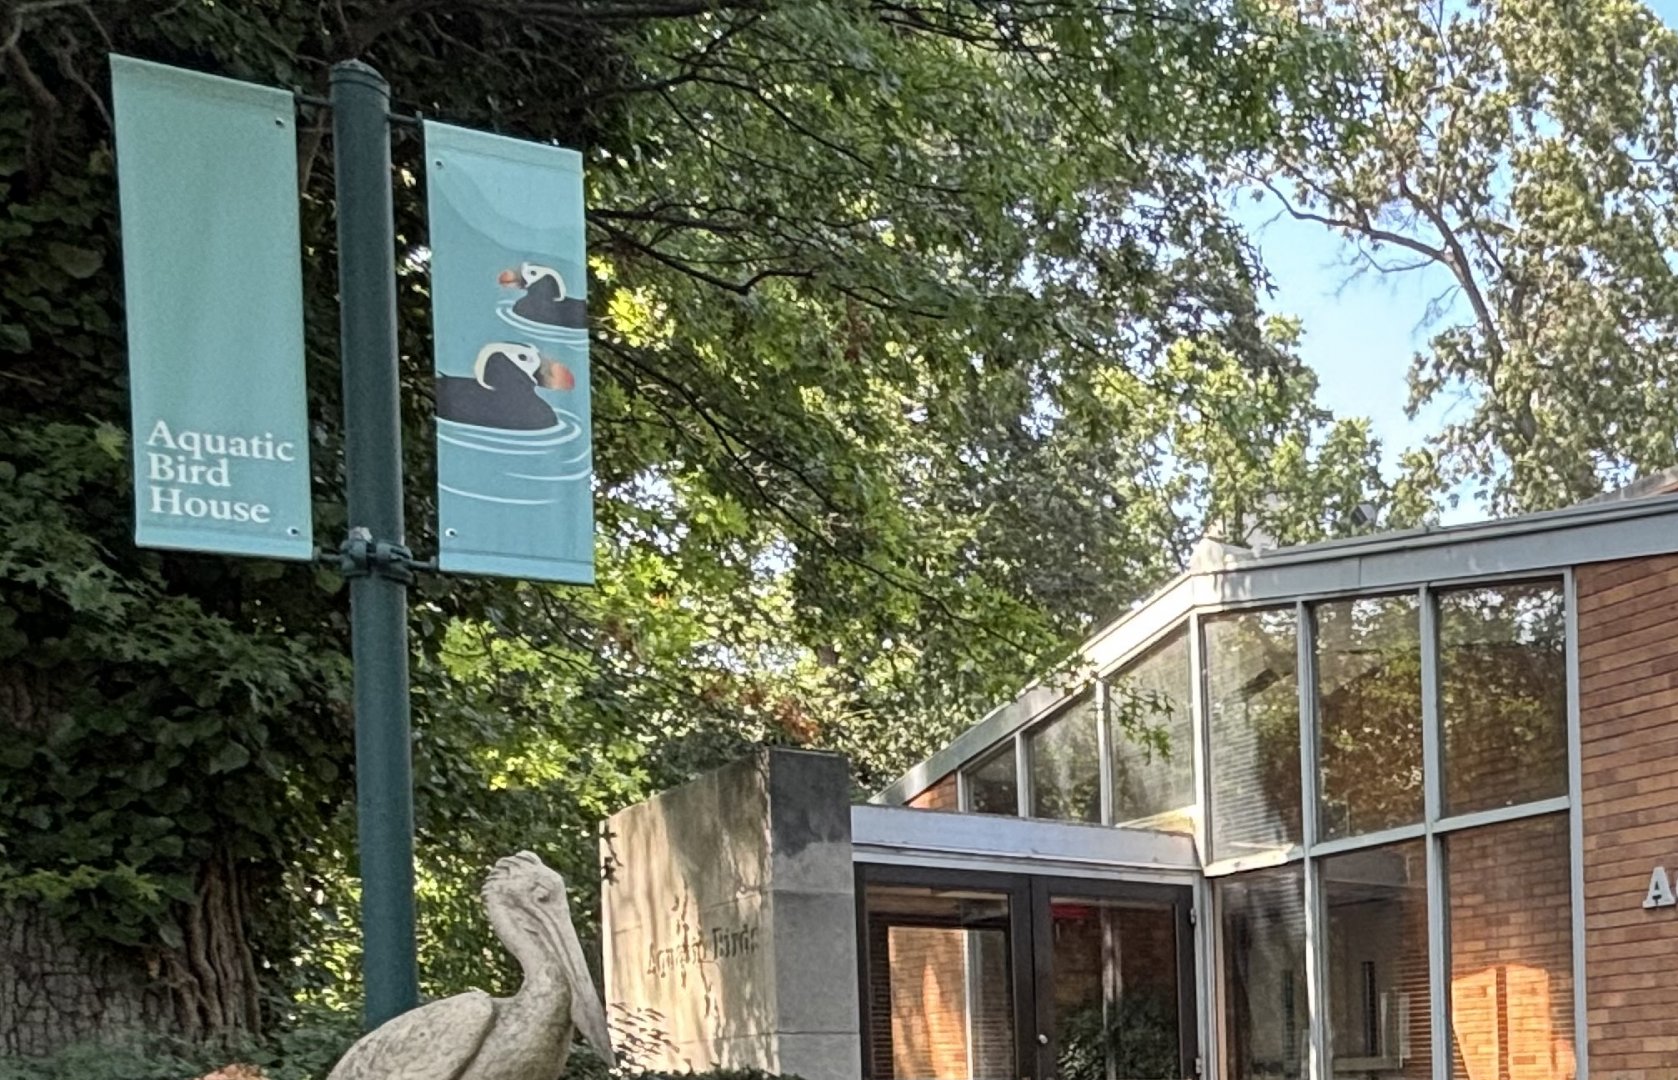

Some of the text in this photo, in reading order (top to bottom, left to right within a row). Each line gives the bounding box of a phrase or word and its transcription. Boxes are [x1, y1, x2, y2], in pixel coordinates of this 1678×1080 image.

[145, 420, 295, 462] Aquatic
[146, 451, 231, 487] Bird
[148, 485, 271, 524] House
